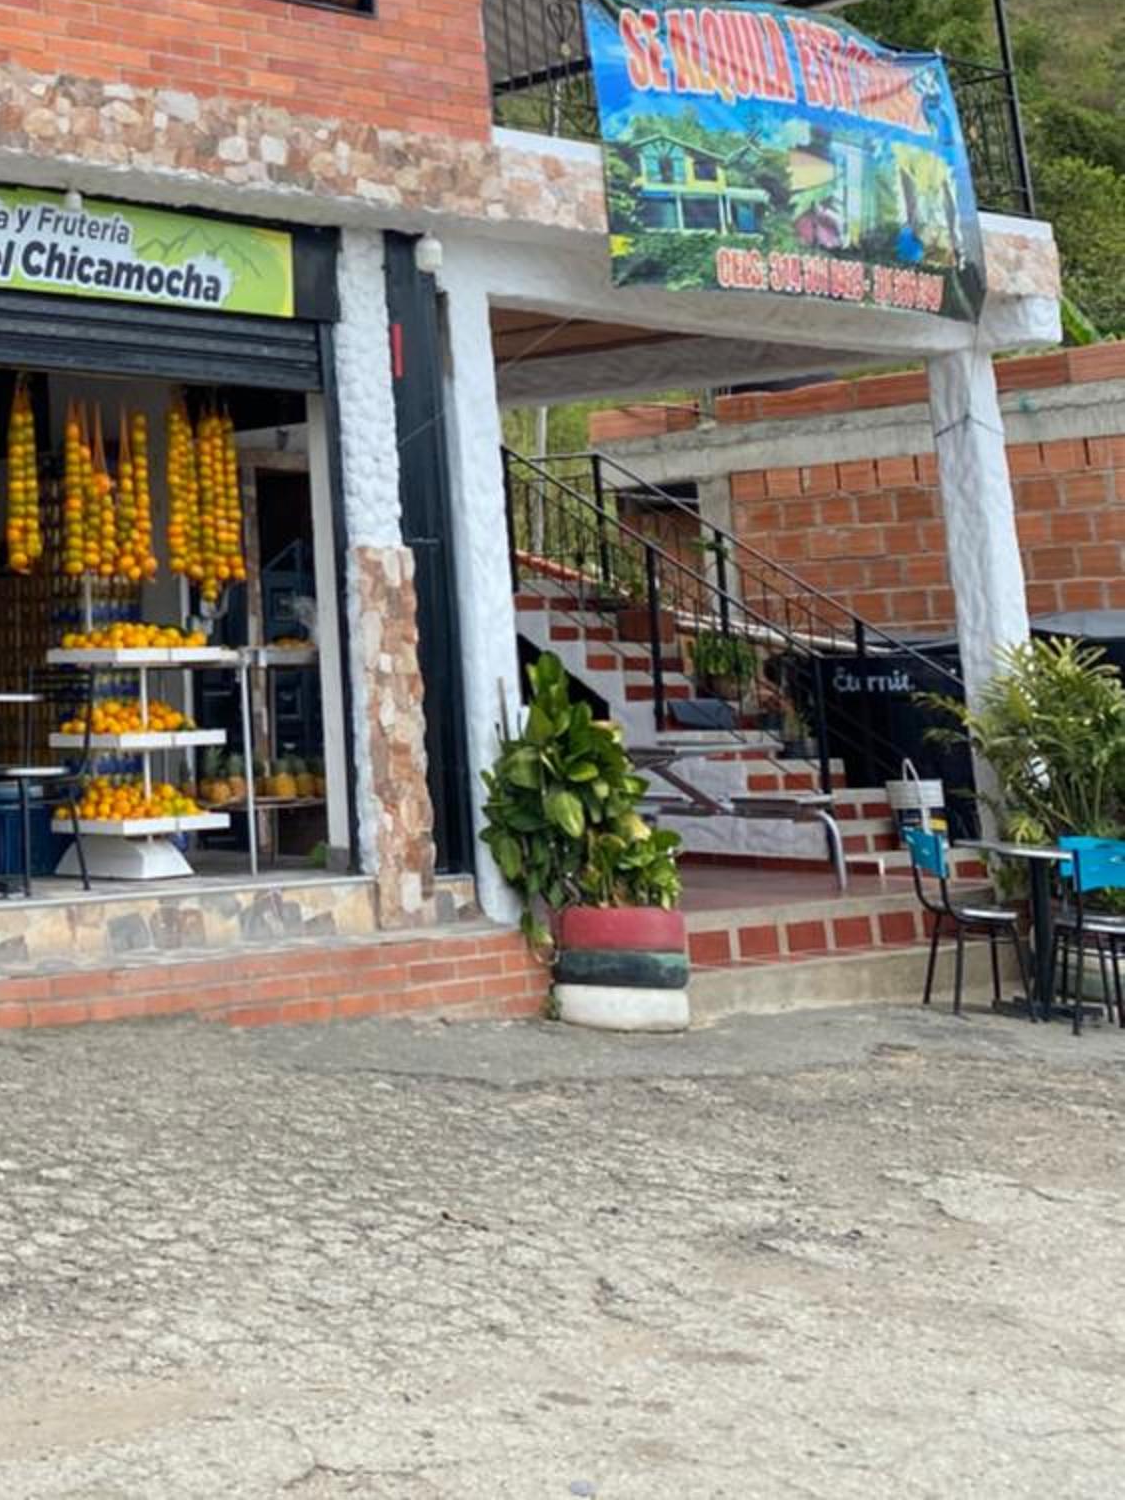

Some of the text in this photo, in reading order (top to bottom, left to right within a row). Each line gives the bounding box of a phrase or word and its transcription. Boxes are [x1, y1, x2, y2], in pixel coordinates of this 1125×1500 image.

[620, 7, 671, 92] SE
[665, 7, 798, 106] ALQUILA
[15, 207, 32, 234] y
[37, 205, 131, 244] Frutería
[21, 240, 222, 302] Chicamocha
